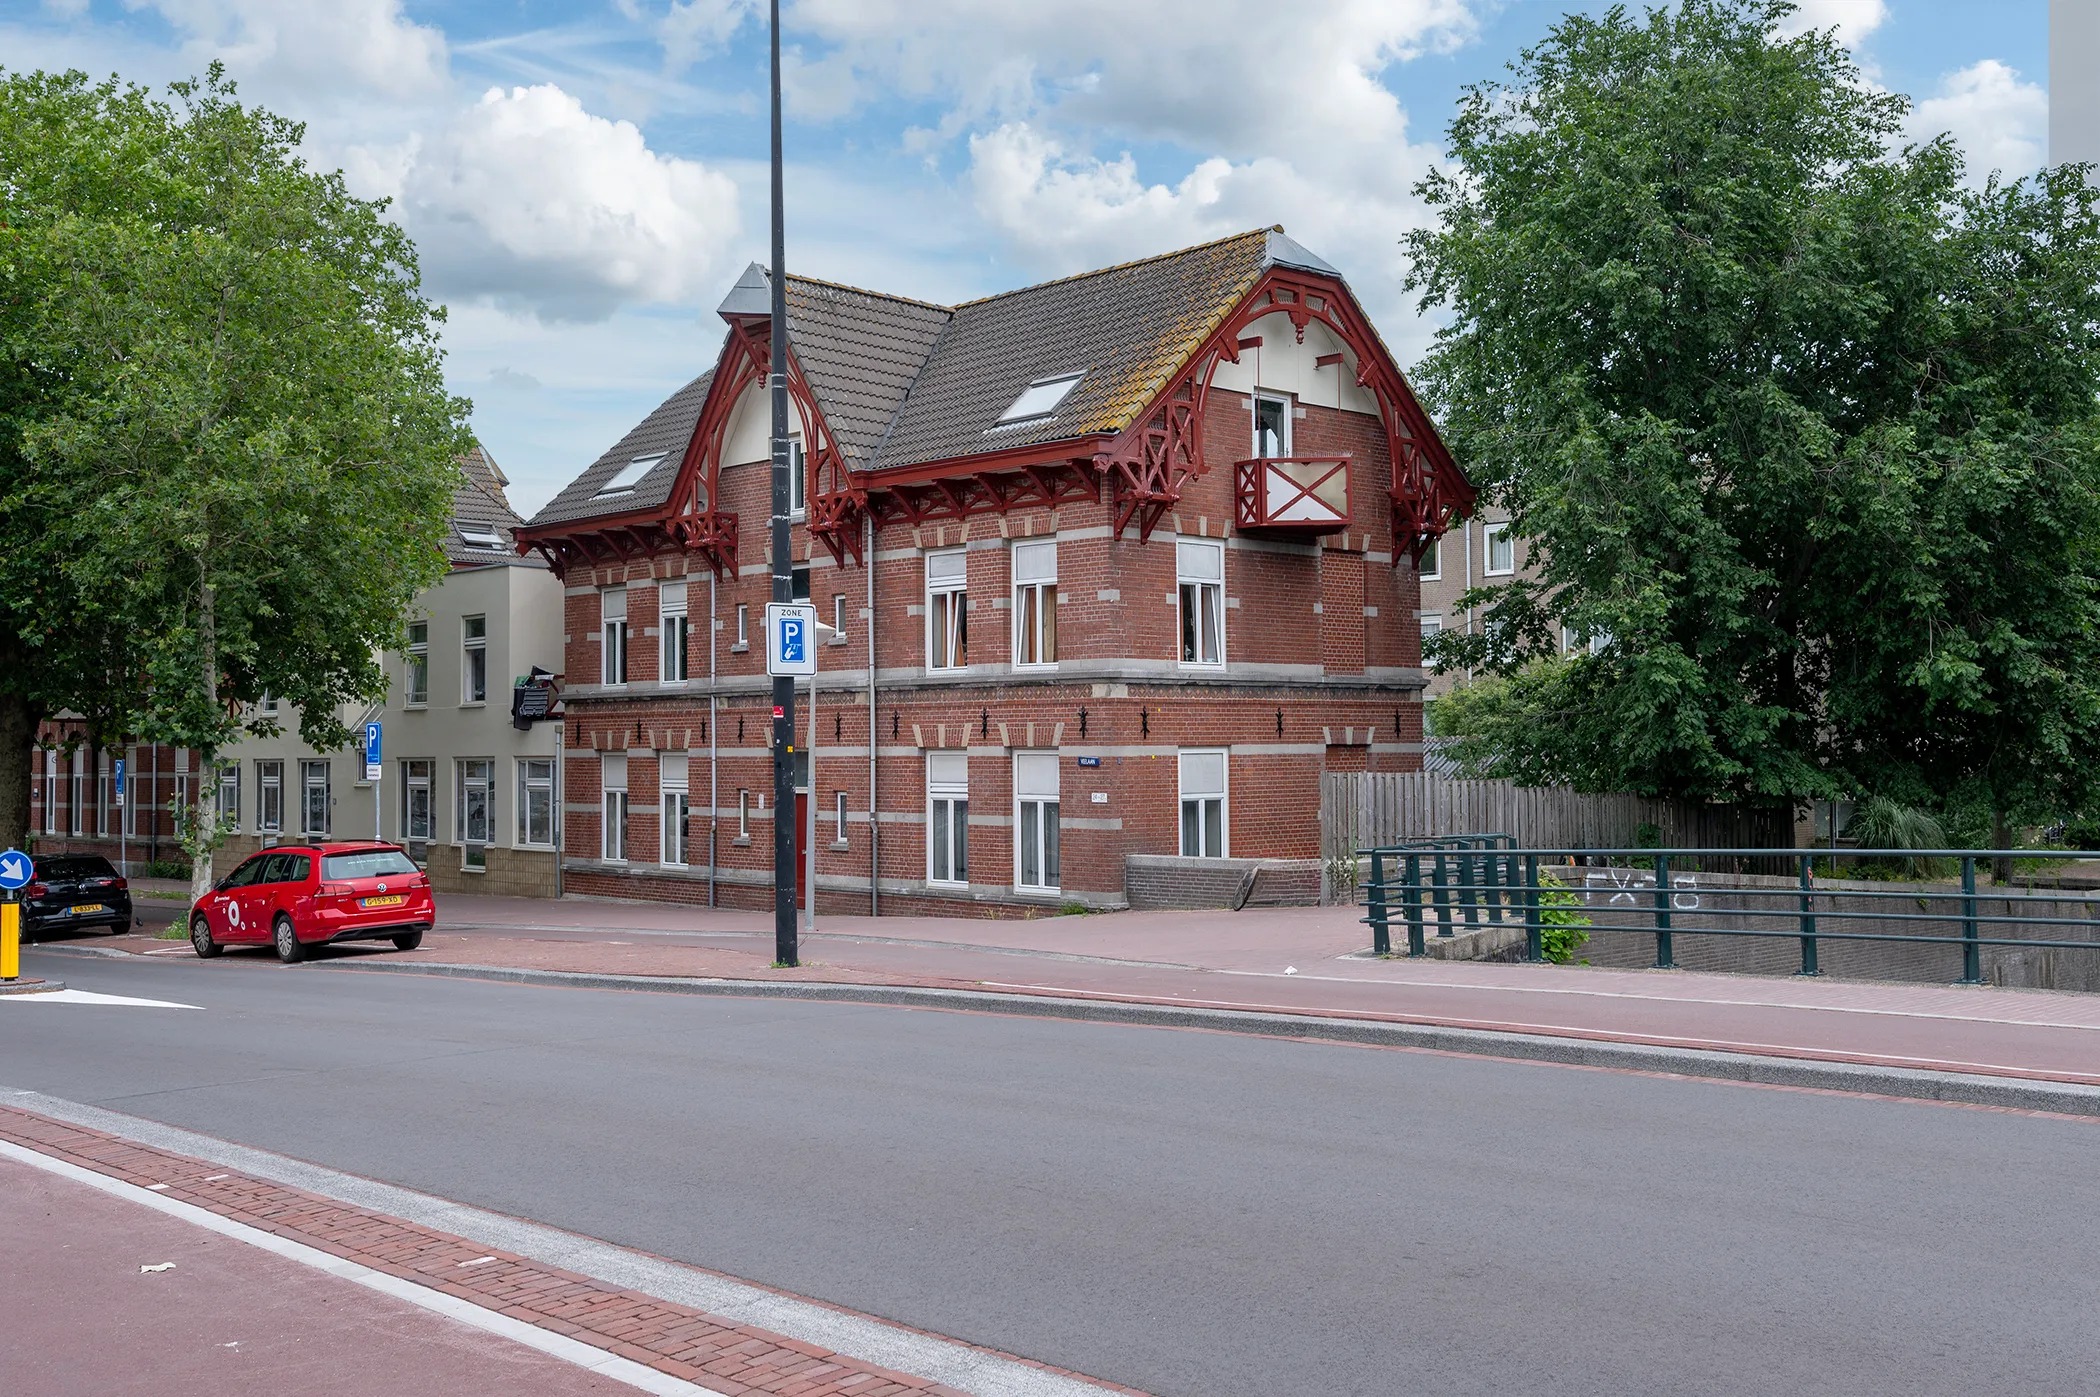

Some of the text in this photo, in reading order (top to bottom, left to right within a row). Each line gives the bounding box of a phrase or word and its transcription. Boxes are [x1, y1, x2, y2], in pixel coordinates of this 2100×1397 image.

[785, 622, 799, 645] P
[369, 726, 377, 748] P
[366, 895, 398, 906] G-159-XD
